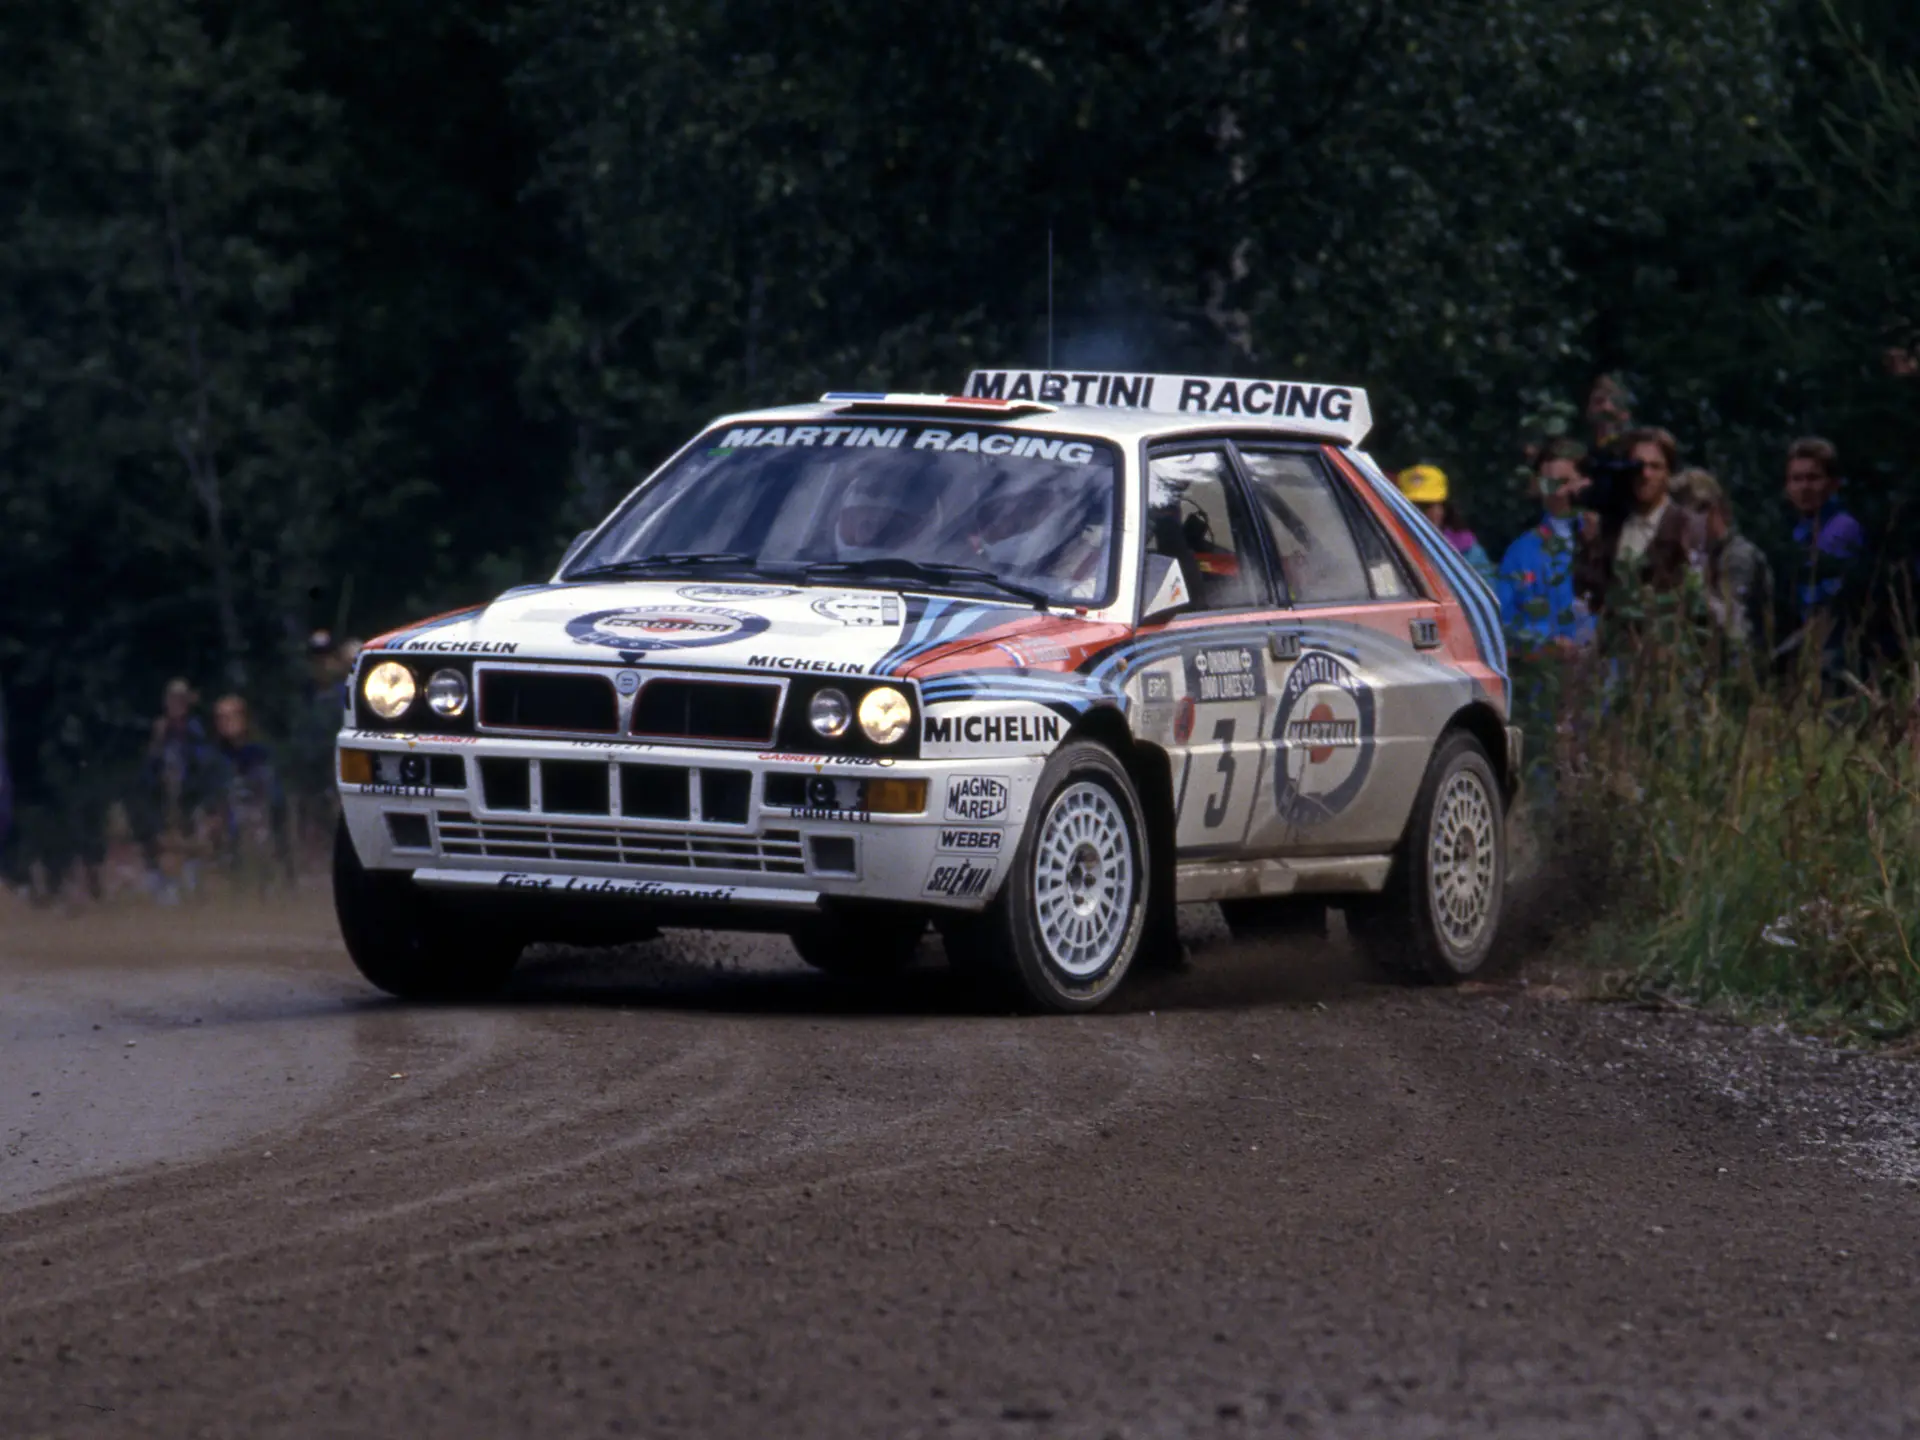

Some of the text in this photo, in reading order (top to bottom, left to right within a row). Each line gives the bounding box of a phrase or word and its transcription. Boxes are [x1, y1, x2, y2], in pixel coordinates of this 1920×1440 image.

[971, 373, 1353, 422] MARTINI RACING
[719, 426, 1095, 464] MARTINI RACING
[408, 640, 520, 654] MICHELIN
[747, 655, 866, 674] MICHELIN
[924, 715, 1060, 742] MICHELIN
[1286, 722, 1355, 745] MARTINI
[1204, 718, 1236, 828] 3
[941, 831, 1002, 849] WEBER
[497, 873, 552, 890] Fiat
